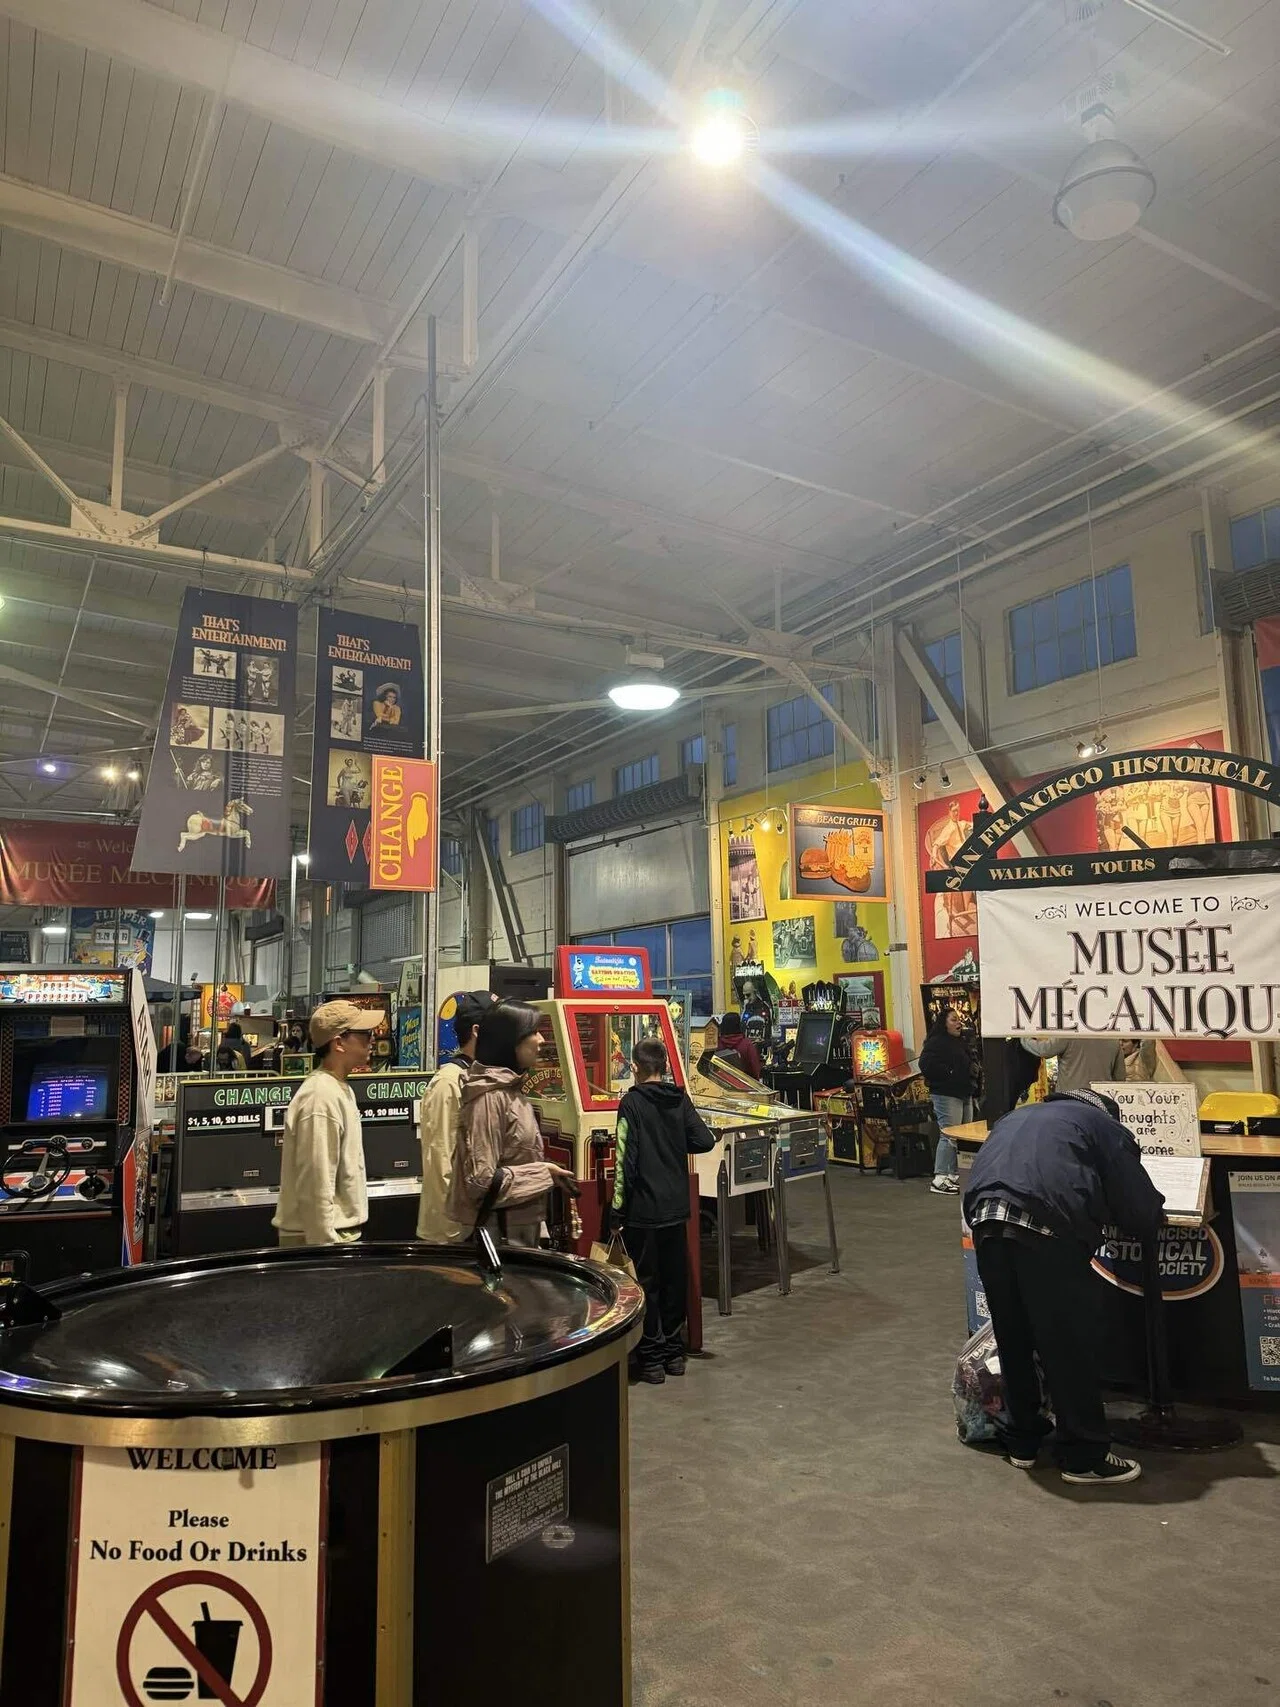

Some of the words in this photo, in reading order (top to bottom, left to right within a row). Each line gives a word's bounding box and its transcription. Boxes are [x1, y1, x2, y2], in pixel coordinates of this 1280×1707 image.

[202, 614, 240, 631] THAT'S
[192, 626, 286, 651] ENTERTAINMENT!
[336, 634, 370, 651] THAT'S
[328, 645, 411, 670] ENTERTAINMENT!
[379, 765, 404, 882] CHANGE
[817, 815, 847, 825] BEACH
[847, 816, 878, 827] GRILLE
[945, 845, 984, 891] SAN
[978, 767, 1103, 848] FRANCISCO
[1111, 755, 1273, 791] HISTORICAL
[96, 838, 134, 857] Welc
[989, 863, 1075, 881] WALKING
[1091, 858, 1156, 875] TOURS
[1075, 898, 1183, 918] WELCOME
[1190, 896, 1220, 912] TO
[94, 908, 147, 927] FLIPER
[1067, 918, 1235, 977] MUSÉE
[1008, 978, 1280, 1039] MÉCANIQU
[214, 1086, 292, 1106] CHANGE
[366, 1081, 428, 1099] CHANG
[1105, 1089, 1134, 1104] You
[1145, 1089, 1181, 1105] Your
[201, 1116, 211, 1127] 5,
[211, 1116, 223, 1126] 10,
[225, 1115, 236, 1124] 20
[237, 1114, 260, 1123] BILLS
[376, 1108, 386, 1117] 20
[387, 1107, 409, 1116] BILLS
[1120, 1109, 1176, 1127] houghts
[1136, 1127, 1156, 1136] are
[1101, 1224, 1118, 1239] AN
[1157, 1226, 1208, 1240] NCISCO
[1159, 1262, 1206, 1276] OCIETY
[126, 1447, 278, 1470] WELCOME
[168, 1508, 229, 1528] Please
[90, 1540, 122, 1560] No
[128, 1539, 183, 1561] Food
[190, 1540, 221, 1561] Or
[227, 1540, 307, 1562] Drinks
